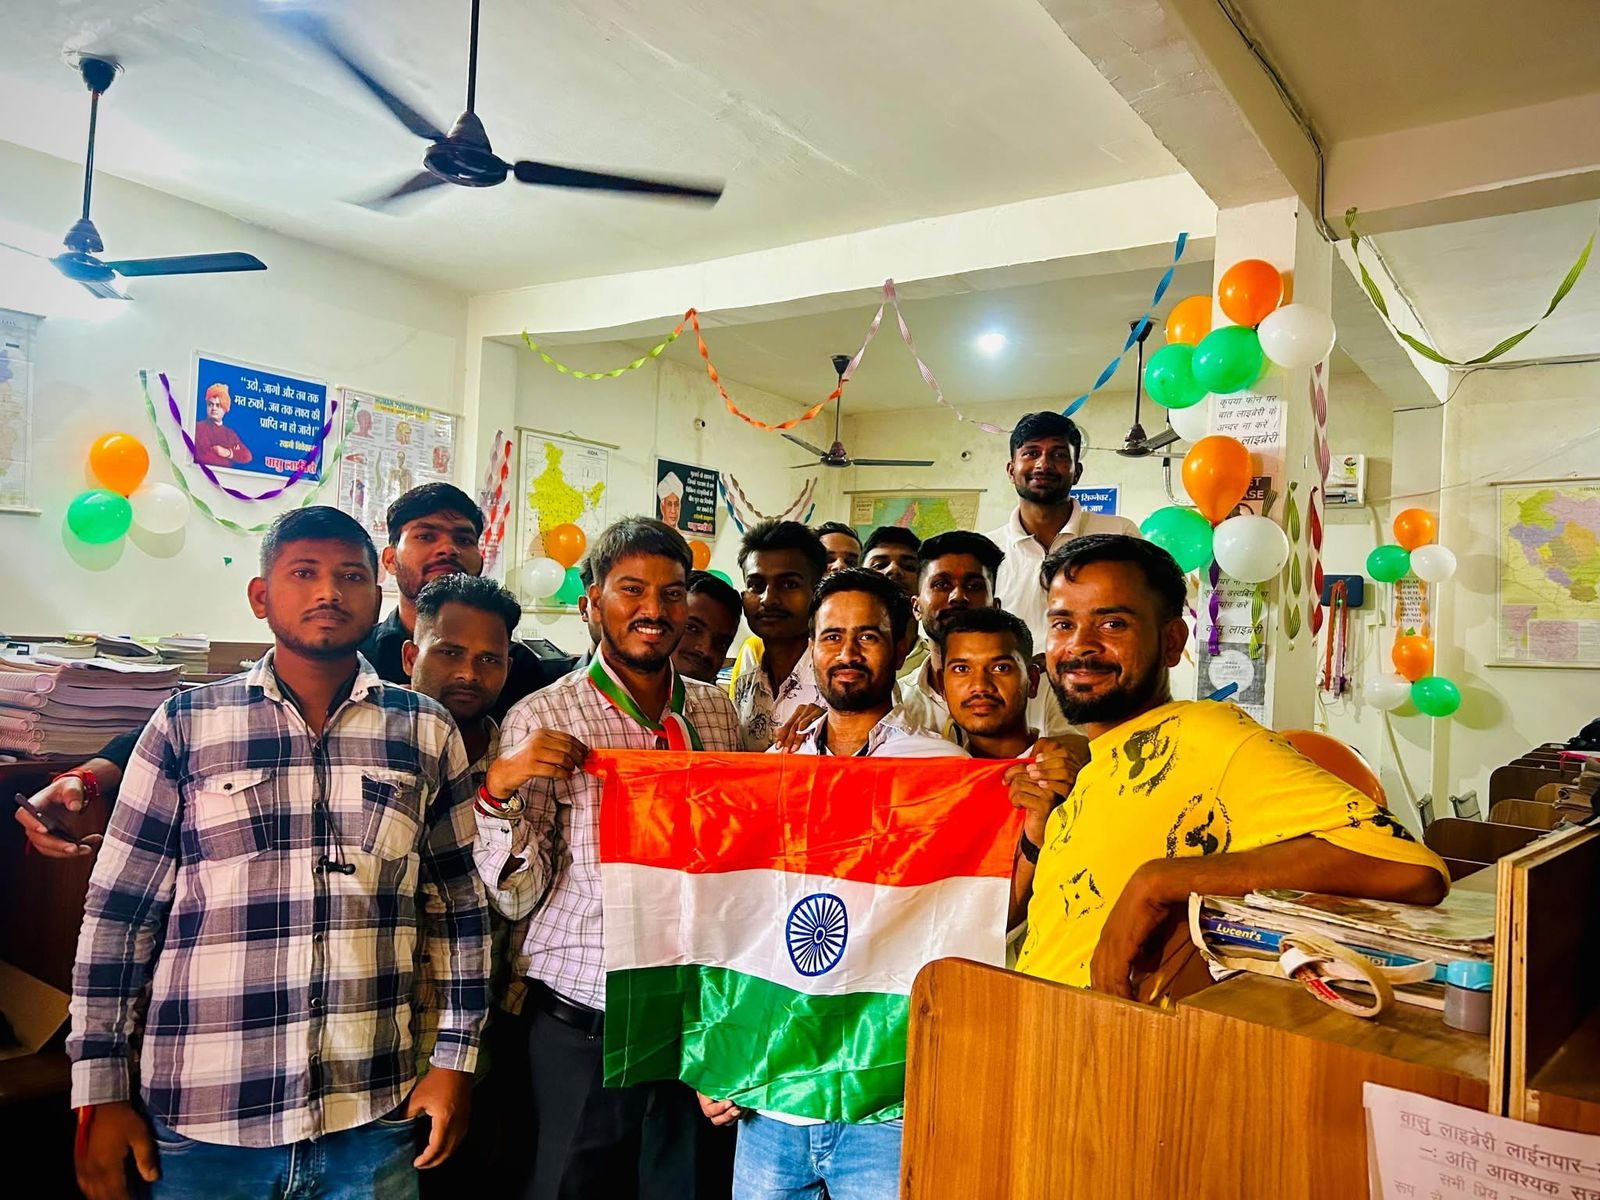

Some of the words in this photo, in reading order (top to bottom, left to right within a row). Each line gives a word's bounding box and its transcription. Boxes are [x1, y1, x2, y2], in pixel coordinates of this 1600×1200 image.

[263, 383, 280, 396] जागो
[282, 385, 295, 399] और
[307, 392, 320, 404] तक
[1220, 397, 1242, 408] कृपया
[234, 394, 246, 407] मत
[268, 401, 280, 413] जब
[281, 404, 293, 415] तक
[311, 408, 320, 421] की
[1236, 406, 1265, 418] लाइब्रेरी
[289, 421, 297, 434] हो
[1242, 422, 1252, 430] ना
[1241, 432, 1279, 445] लाइब्रेरी
[1216, 923, 1262, 941] Lucent's
[1400, 1111, 1431, 1136] वासु
[1438, 1121, 1496, 1151] लाइब्रेरी
[1439, 1173, 1465, 1191] सभी
[1446, 1151, 1480, 1172] अति
[1486, 1164, 1560, 1195] आवश्यक
[1393, 1179, 1416, 1197] रूप
